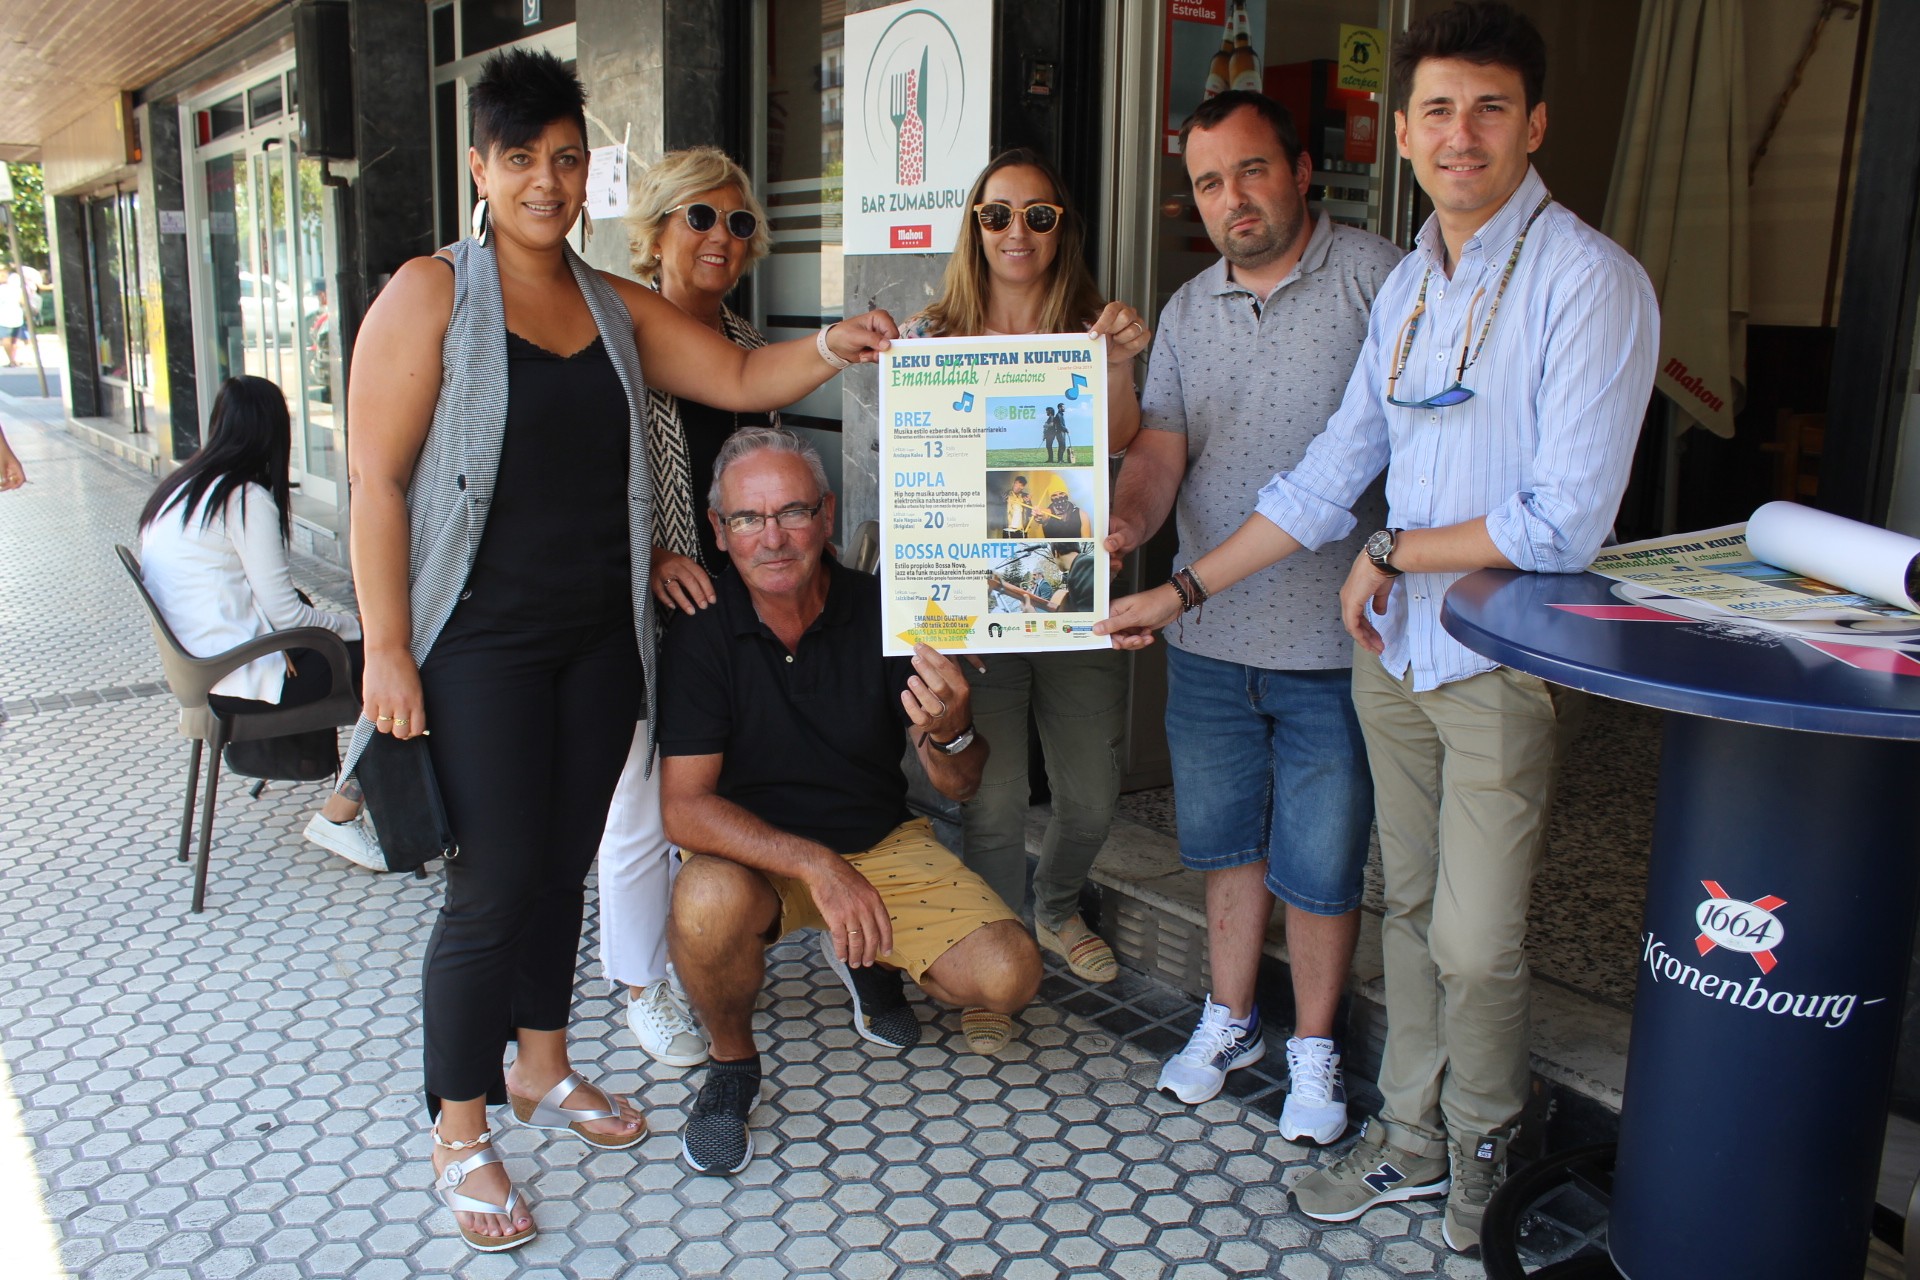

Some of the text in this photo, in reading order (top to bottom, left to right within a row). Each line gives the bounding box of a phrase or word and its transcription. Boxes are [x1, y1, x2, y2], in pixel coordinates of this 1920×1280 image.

[527, 0, 536, 18] 9
[1172, 3, 1216, 20] Estrellas
[861, 188, 965, 214] BAR ZUMABURU
[897, 228, 924, 241] Mahou
[892, 349, 1092, 368] LEKU GUZTIETAN KULTURA
[891, 357, 979, 387] Emanaldiak
[994, 369, 1046, 384] Actuaciones
[1663, 357, 1724, 412] Mahou
[894, 411, 931, 427] BREZ
[1009, 405, 1036, 420] Brez
[929, 427, 960, 435] ezberdinak,
[924, 440, 943, 458] 13
[894, 471, 945, 487] DUPLA
[924, 511, 945, 529] 20
[894, 542, 1018, 560] BOSSA QUARTET
[1594, 554, 1621, 562] EKU
[1622, 542, 1705, 560] GUZTIETAN
[910, 562, 935, 570] propioko
[1592, 551, 1680, 571] Emanaldiak
[1693, 550, 1742, 562] Actuaciones
[931, 584, 951, 601] 27
[1701, 904, 1775, 944] 1664
[1643, 932, 1857, 1028] Kronenbourg
